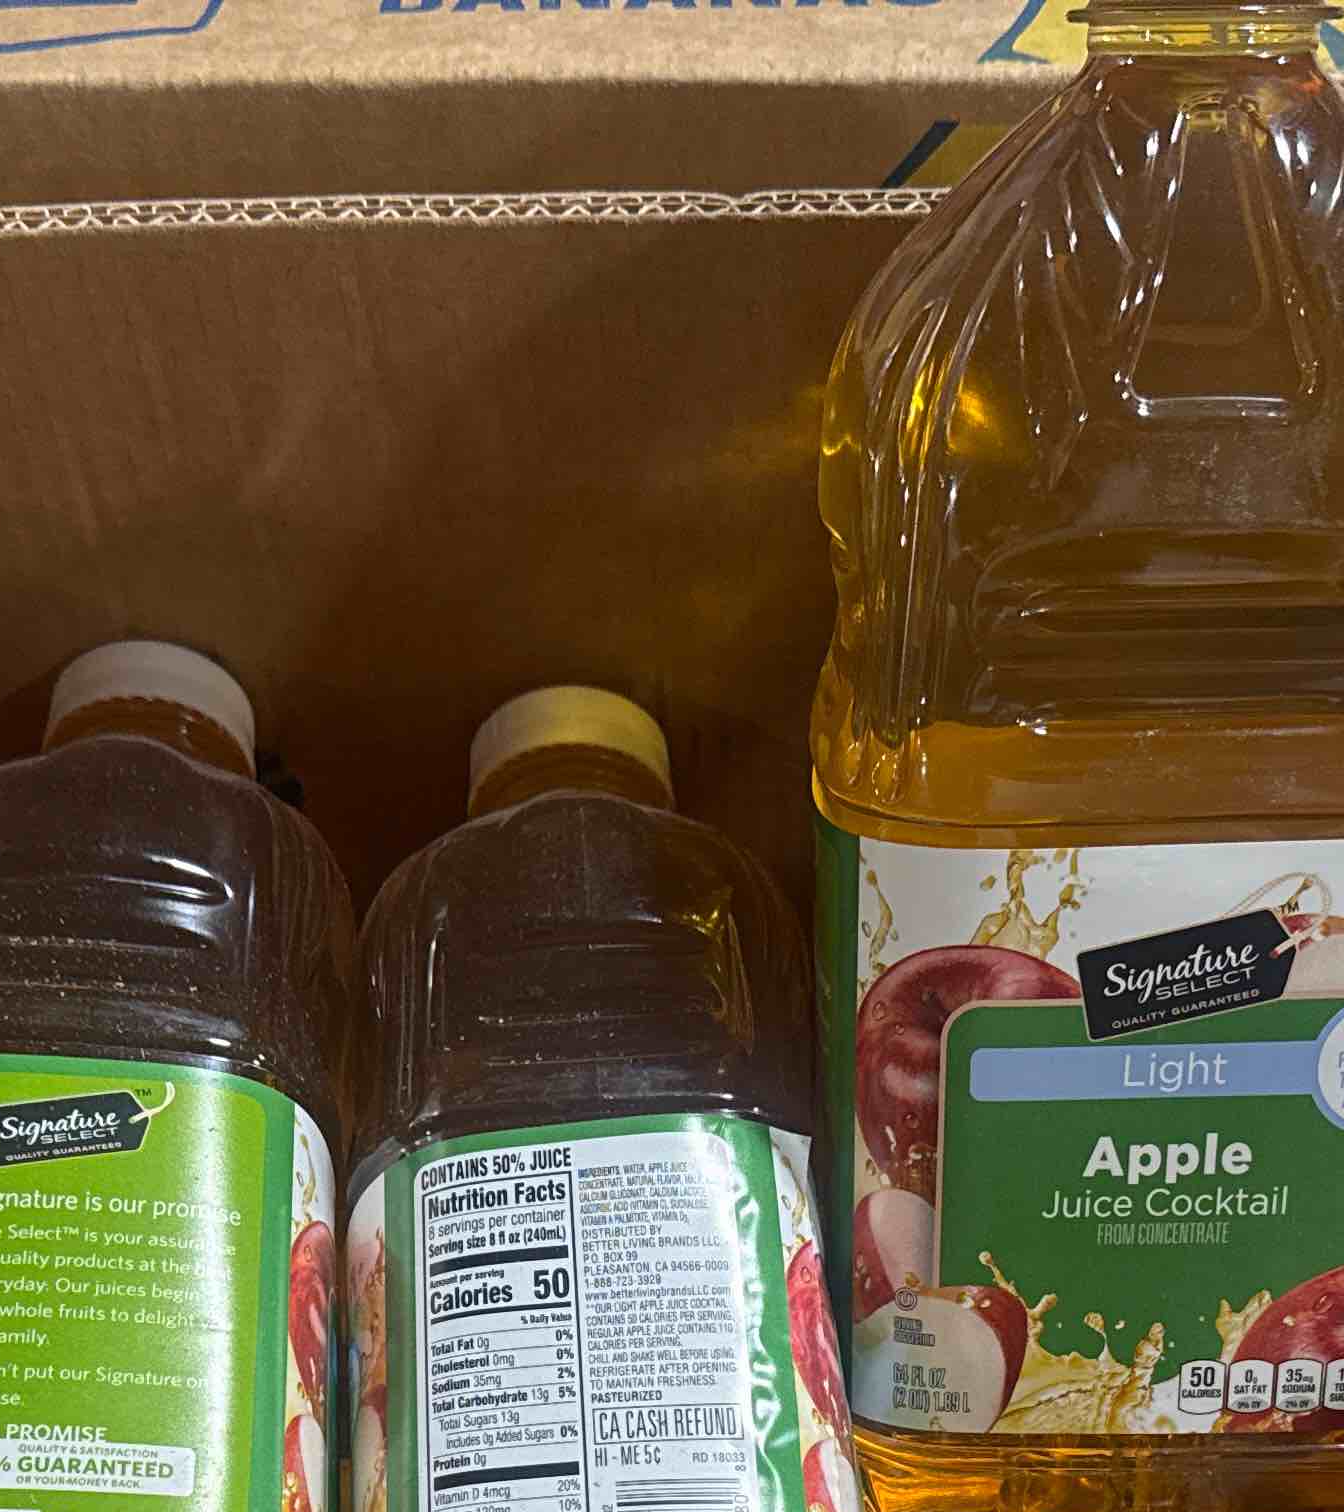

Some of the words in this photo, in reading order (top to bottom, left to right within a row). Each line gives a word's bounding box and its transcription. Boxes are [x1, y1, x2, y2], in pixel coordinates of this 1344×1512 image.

[1104, 944, 1260, 1003] Signature
[1155, 966, 1257, 1000] SELECT
[1111, 1010, 1166, 1029] QUALITY
[1171, 988, 1260, 1017] GUARANTEED
[1123, 1052, 1228, 1092] Light
[0, 1109, 121, 1145] Signature
[40, 1127, 118, 1144] SELECT
[6, 1150, 50, 1161] QUALITY
[52, 1142, 122, 1154] GUARANTEED
[1083, 1132, 1253, 1183] Apple
[421, 1157, 488, 1191] CONTAINS
[493, 1152, 526, 1175] 50%
[530, 1148, 571, 1171] JUICE
[86, 1192, 102, 1210] is
[109, 1197, 143, 1214] our
[428, 1188, 508, 1219] Nutrition
[514, 1179, 566, 1204] Facts
[1042, 1191, 1135, 1220] Juice
[1146, 1186, 1288, 1218] Cocktail
[429, 1238, 463, 1258] Serving
[467, 1233, 486, 1249] size
[490, 1233, 495, 1245] 8
[499, 1232, 505, 1245] fl
[508, 1232, 520, 1244] oz
[524, 1226, 566, 1245] (240mL)
[582, 1239, 620, 1252] BETTER
[623, 1237, 655, 1250] LIVING
[659, 1236, 700, 1247] BRANDS
[1097, 1224, 1136, 1246] FROM
[1138, 1220, 1230, 1245] CONCENTRATE
[431, 1282, 513, 1315] Calories
[533, 1268, 569, 1300] 50
[432, 1341, 455, 1357] Total
[458, 1338, 474, 1350] Fat
[477, 1337, 489, 1350] 0g
[556, 1329, 573, 1341] 0%
[432, 1355, 489, 1376] Cholesterol
[493, 1353, 515, 1367] 0mg
[557, 1348, 574, 1360] 0%
[25, 1365, 54, 1381] put
[60, 1369, 90, 1382] our
[96, 1367, 181, 1387] Signature
[928, 1367, 946, 1389] OZ
[1190, 1366, 1215, 1387] 50
[1281, 1384, 1315, 1393] SODIUM
[591, 1391, 662, 1403] PASTEURIZED
[1181, 1388, 1222, 1399] CALORIES
[1233, 1385, 1250, 1394] SAT
[1252, 1385, 1267, 1393] FAT
[7, 1425, 108, 1441] PROMISE
[599, 1412, 620, 1440] CA
[625, 1409, 668, 1438] CASH
[674, 1407, 736, 1437] REFUND
[17, 1457, 173, 1478] GUARANTEED
[595, 1448, 607, 1466] HI
[621, 1445, 640, 1465] ME
